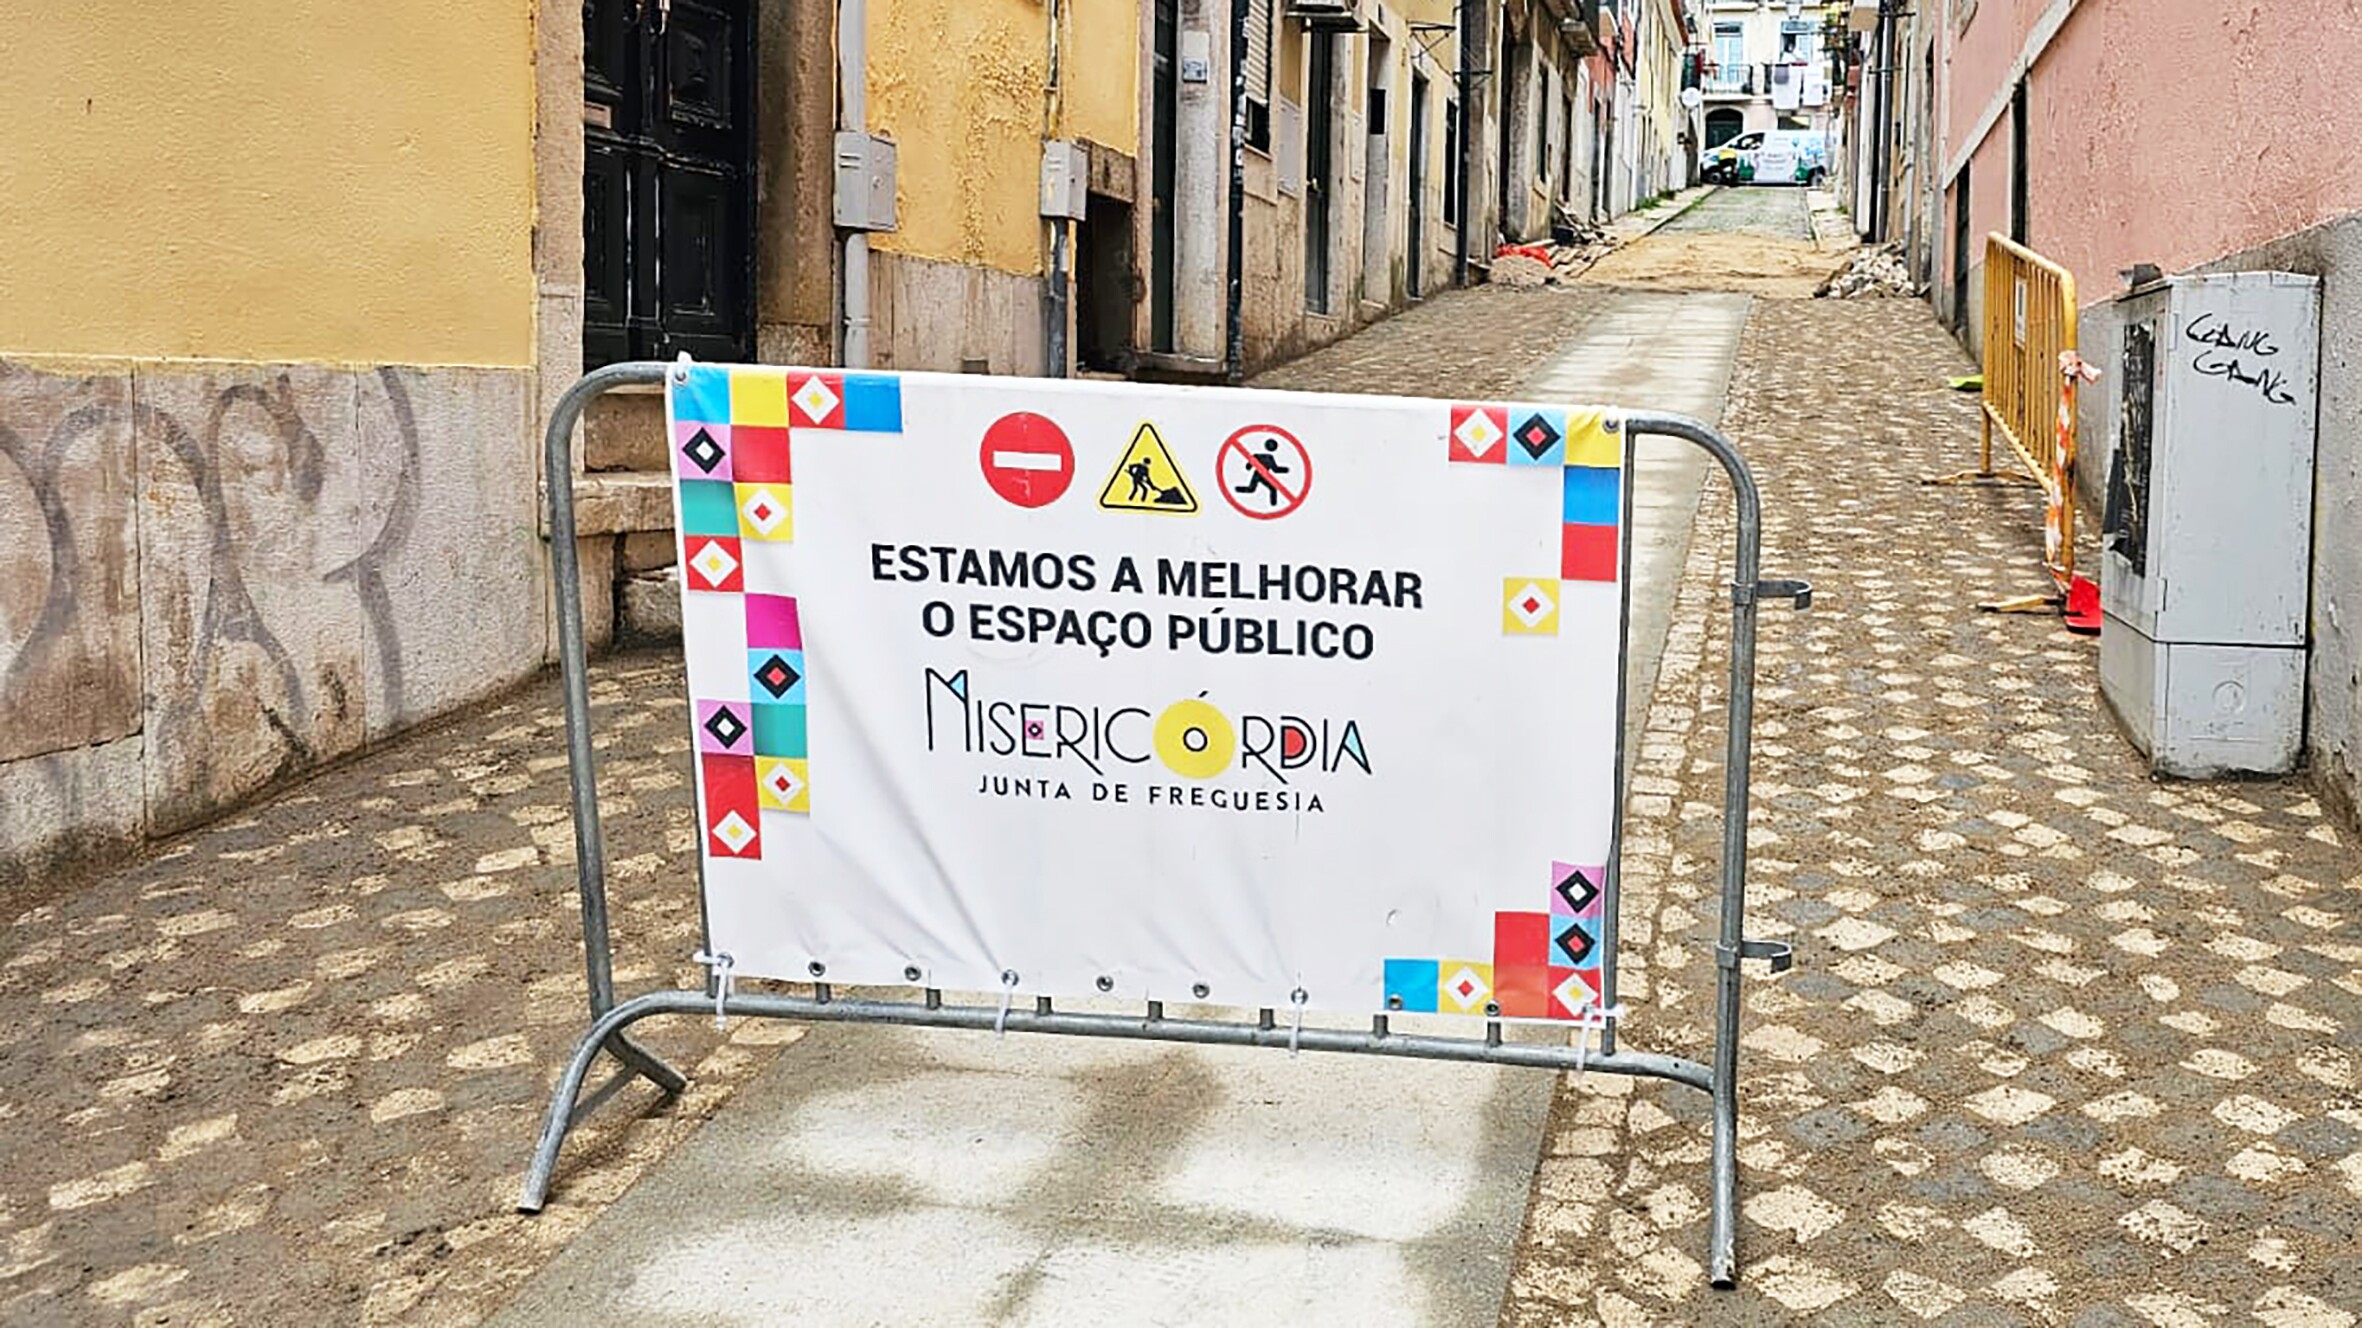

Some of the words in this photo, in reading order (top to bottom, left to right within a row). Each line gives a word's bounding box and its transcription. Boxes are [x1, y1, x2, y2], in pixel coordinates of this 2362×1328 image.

[871, 543, 1097, 592] ESTAMOS
[1110, 556, 1144, 594] A
[1157, 558, 1424, 609] MELHORAR
[922, 600, 955, 638] O
[969, 603, 1152, 658] ESPAÇO
[1168, 606, 1375, 661] PÚBLICO
[978, 775, 1071, 800] JUNTA
[1092, 782, 1128, 803] DE
[1148, 785, 1324, 813] FREGUESIA
